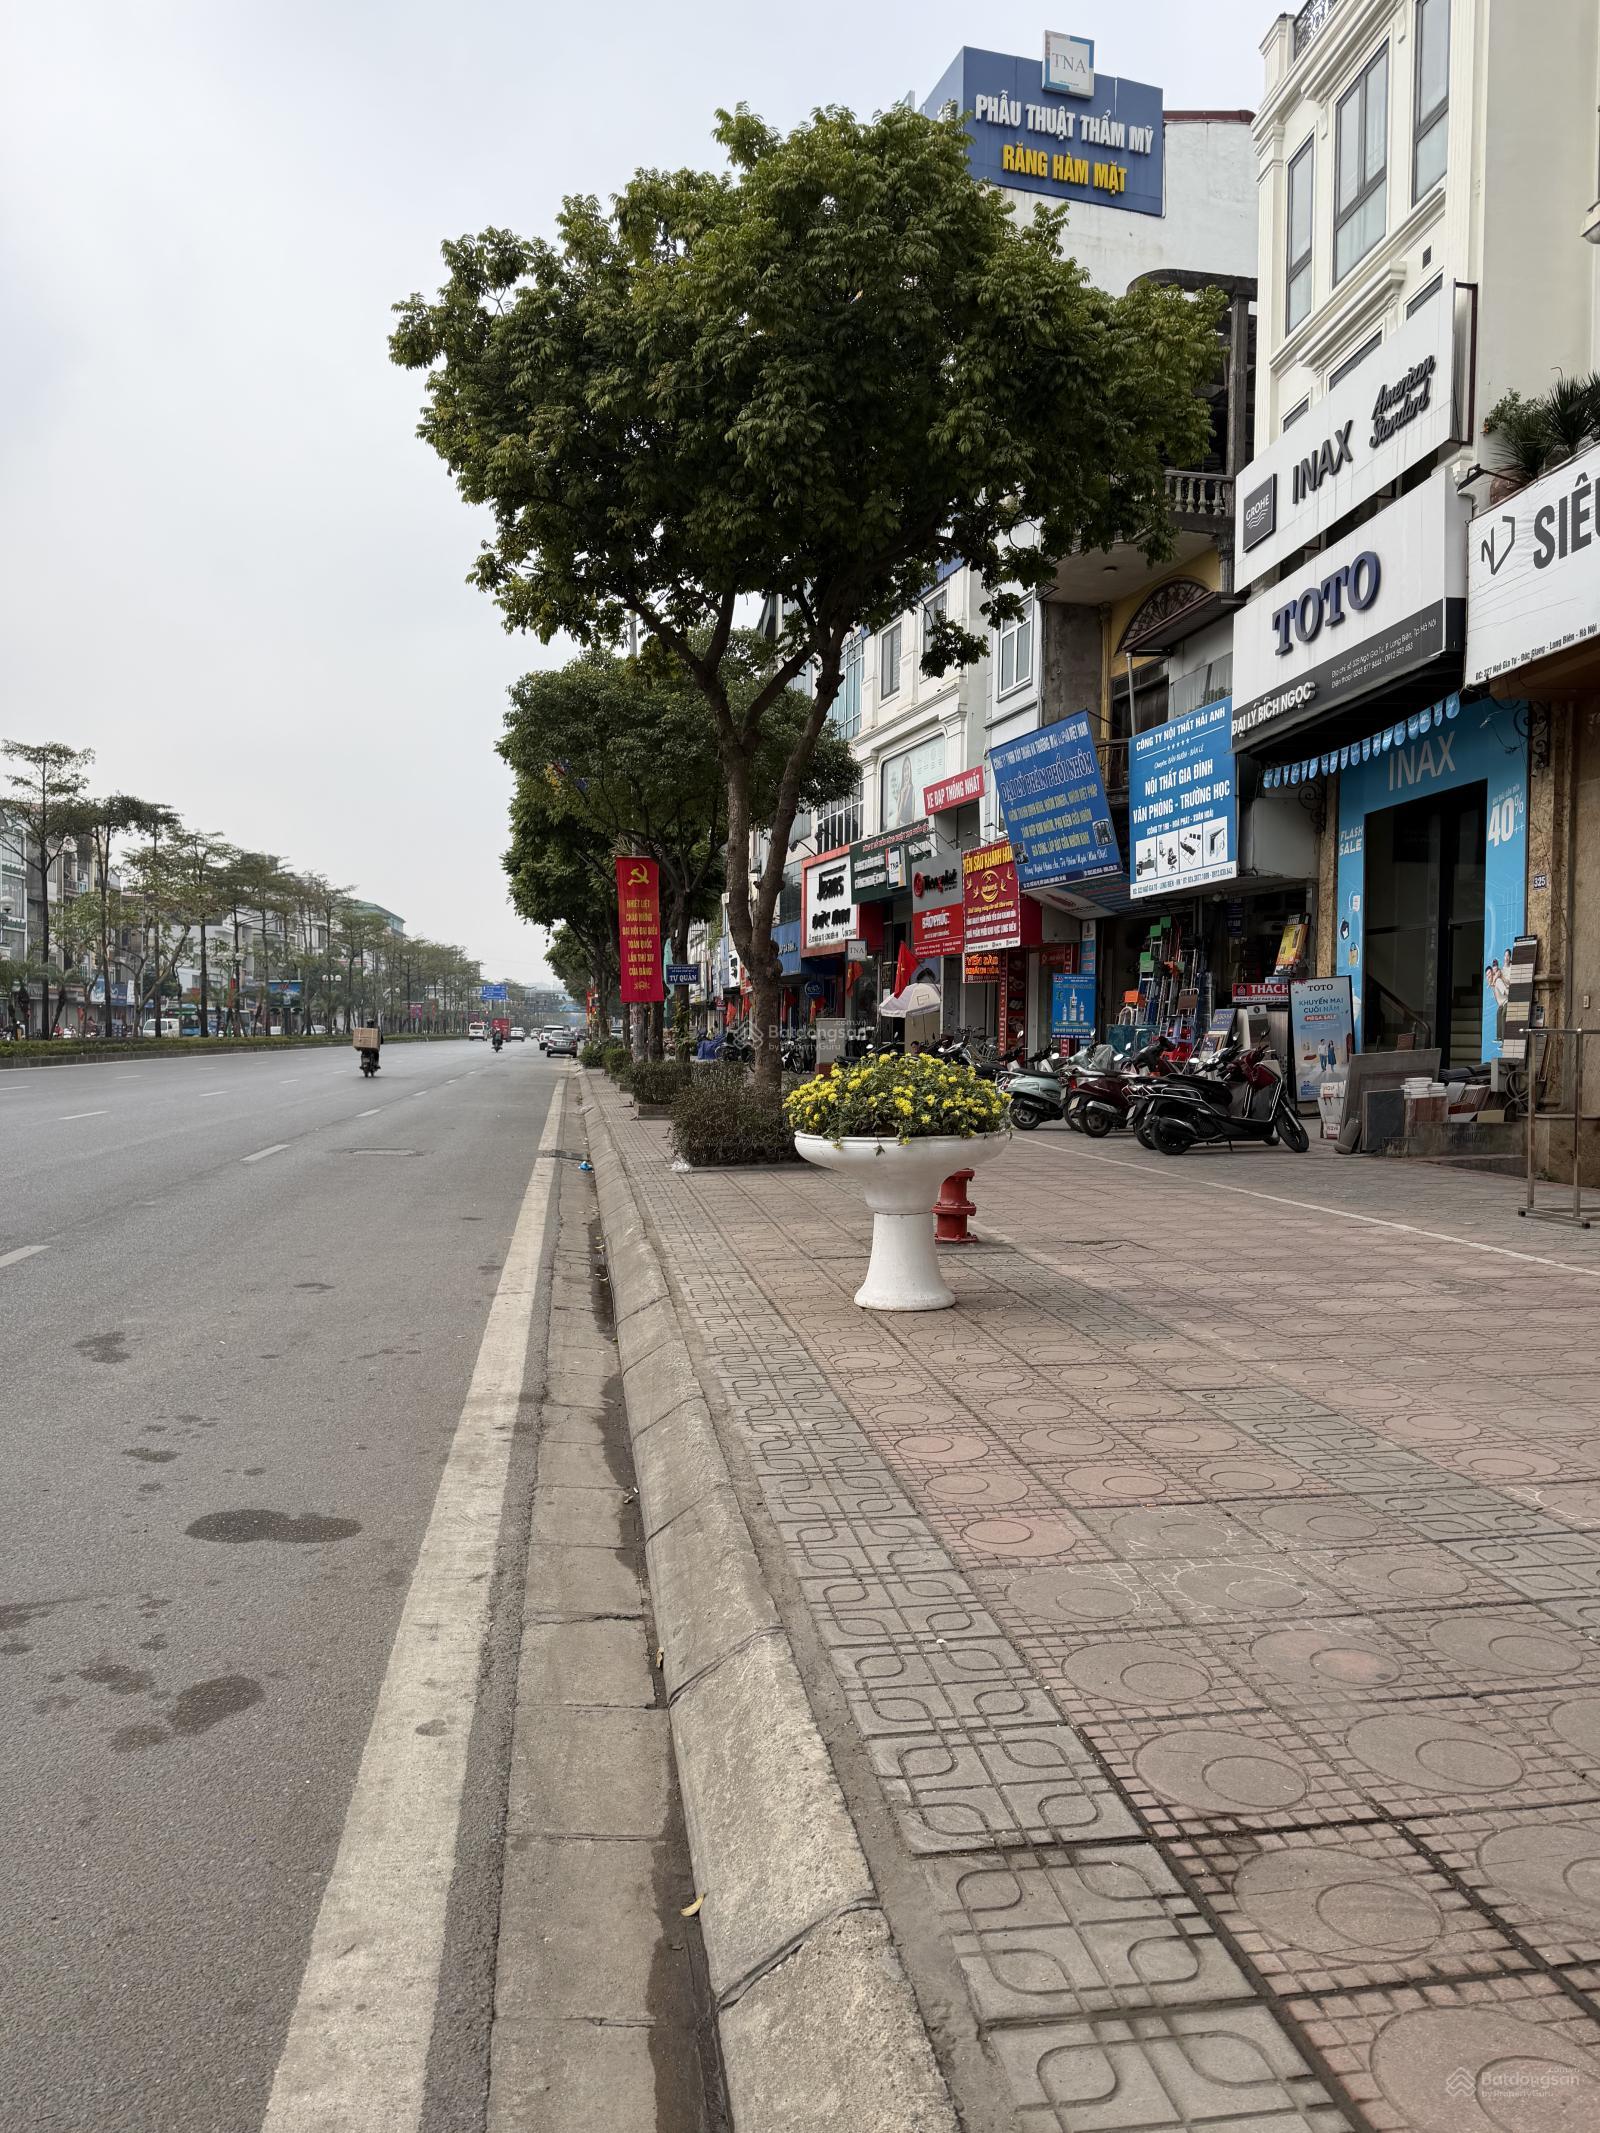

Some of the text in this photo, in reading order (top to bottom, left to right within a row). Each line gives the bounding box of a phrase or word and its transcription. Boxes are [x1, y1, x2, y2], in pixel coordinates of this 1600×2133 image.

[1052, 53, 1087, 74] TNA
[975, 90, 1154, 155] PHẪU THUẬT THẨM MỸ
[1002, 141, 1128, 194] RĂNG HÀM MẶT
[1370, 355, 1437, 421] American
[1369, 375, 1432, 449] Standard
[1292, 420, 1353, 505] INAX
[1245, 494, 1270, 522] GROHE
[1533, 471, 1600, 570] SIÊ
[1272, 551, 1381, 656] TOTO
[1587, 623, 1598, 635] Nội
[1136, 707, 1225, 751] CÔNG TY NỘI THẤT HẢI ANH
[1232, 681, 1316, 738] ĐẠI LÝ BÍCH NGỌC
[1145, 759, 1214, 797] NỘI THẤT GIA ĐÌNH
[1389, 731, 1456, 792] INAX
[926, 769, 980, 809] XE ĐẠP THỐNG NHẤT
[1132, 805, 1148, 824] VĂN
[1148, 798, 1174, 820] PHÒNG
[1180, 786, 1212, 810] TRƯỜNG
[1213, 780, 1230, 801] HỌC
[1338, 838, 1363, 857] SALE
[1340, 825, 1363, 840] FLASH
[1534, 876, 1546, 887] 325
[669, 974, 679, 983] TỰ
[679, 972, 697, 982] QUẢN
[1307, 984, 1334, 992] TOTO
[1299, 996, 1329, 1006] KHUYẾN
[1303, 1004, 1340, 1013] CUỐI NĂM
